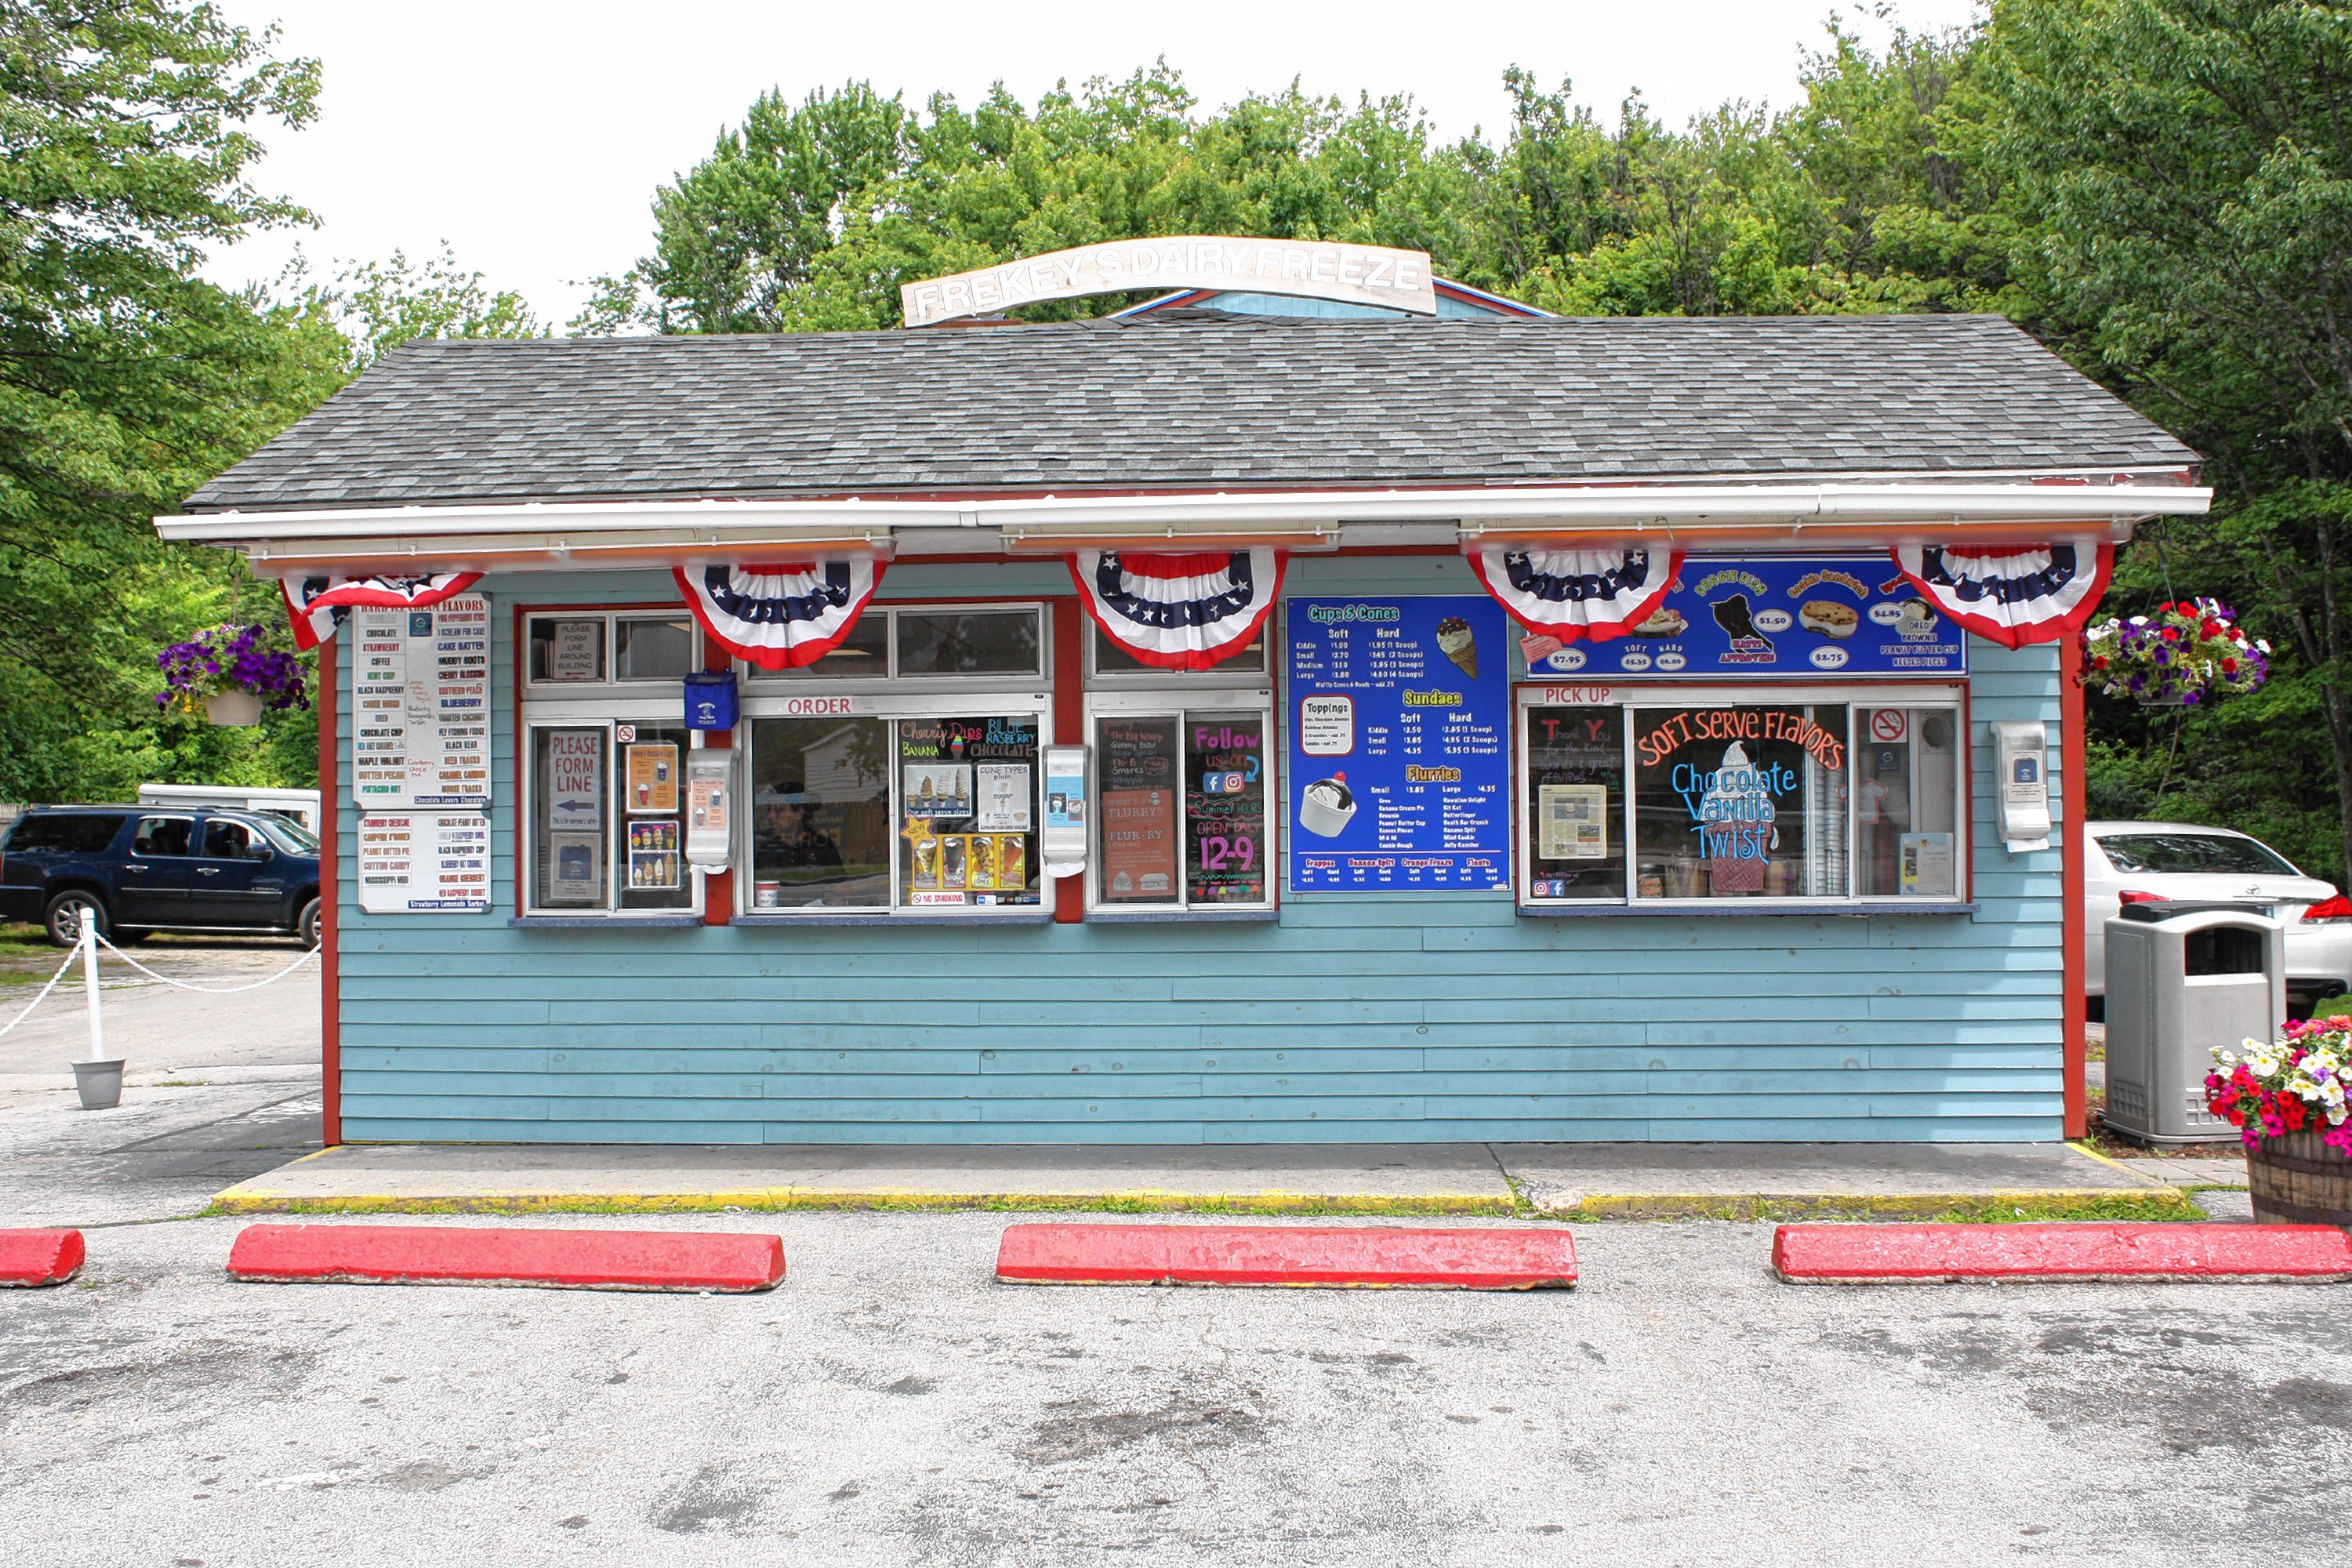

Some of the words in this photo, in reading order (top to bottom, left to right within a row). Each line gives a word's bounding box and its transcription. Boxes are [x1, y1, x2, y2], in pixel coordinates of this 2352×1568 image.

[913, 249, 1124, 319] FREKEY'S
[1129, 242, 1254, 278] DAIRY
[1254, 246, 1424, 292] FREEZE
[1308, 604, 1343, 625] Cups
[1343, 605, 1356, 622] &
[1356, 604, 1399, 622] Cones
[1759, 616, 1787, 626] $1.50
[366, 629, 397, 637] CHOCOLATE
[1328, 629, 1348, 639] Soft
[1377, 628, 1400, 638] Hard
[1901, 633, 1938, 642] BROWNIE
[363, 643, 399, 652] STRAWBERRY
[437, 642, 456, 652] CAKE
[458, 641, 485, 651] BATTER
[1881, 645, 1911, 655] PEANUT
[1911, 645, 1943, 654] BUTTER
[1944, 645, 1958, 654] CUP
[371, 658, 391, 666] COFFEE
[463, 656, 485, 665] BOOTS
[1553, 655, 1581, 664] $7.95
[1815, 654, 1842, 662] $2.75
[1893, 657, 1921, 666] REESES
[1921, 657, 1947, 666] PIECES
[358, 686, 375, 695] BLACK
[1544, 688, 1584, 704] PICK
[1588, 688, 1611, 703] UP
[441, 699, 482, 708] BLUEBERRY
[1403, 689, 1463, 707] Sundaes
[788, 698, 851, 715] ORDER
[1307, 702, 1348, 714] Toppings
[1400, 713, 1421, 723] Soft
[1448, 713, 1472, 723] Hard
[987, 719, 1025, 734] BLUE
[901, 722, 948, 746] Cherry
[947, 722, 982, 743] Dips
[985, 733, 1036, 744] RASBERRY
[1195, 727, 1260, 750] Follow
[1637, 712, 1689, 767] SOFT
[553, 736, 597, 755] PLEASE
[970, 743, 1035, 757] CHOCOLATE
[555, 757, 593, 775] FORM
[1206, 755, 1223, 767] us
[1229, 754, 1247, 767] on
[1004, 765, 1029, 774] TYPES
[1405, 764, 1461, 783] Flurries
[557, 776, 593, 793] LINE
[1671, 760, 1798, 797] Chocolate
[1194, 800, 1234, 815] Summer
[908, 822, 925, 835] NEW
[1197, 822, 1229, 836] OPEN
[1690, 823, 1769, 865] Twist
[1200, 836, 1254, 871] 12-9
